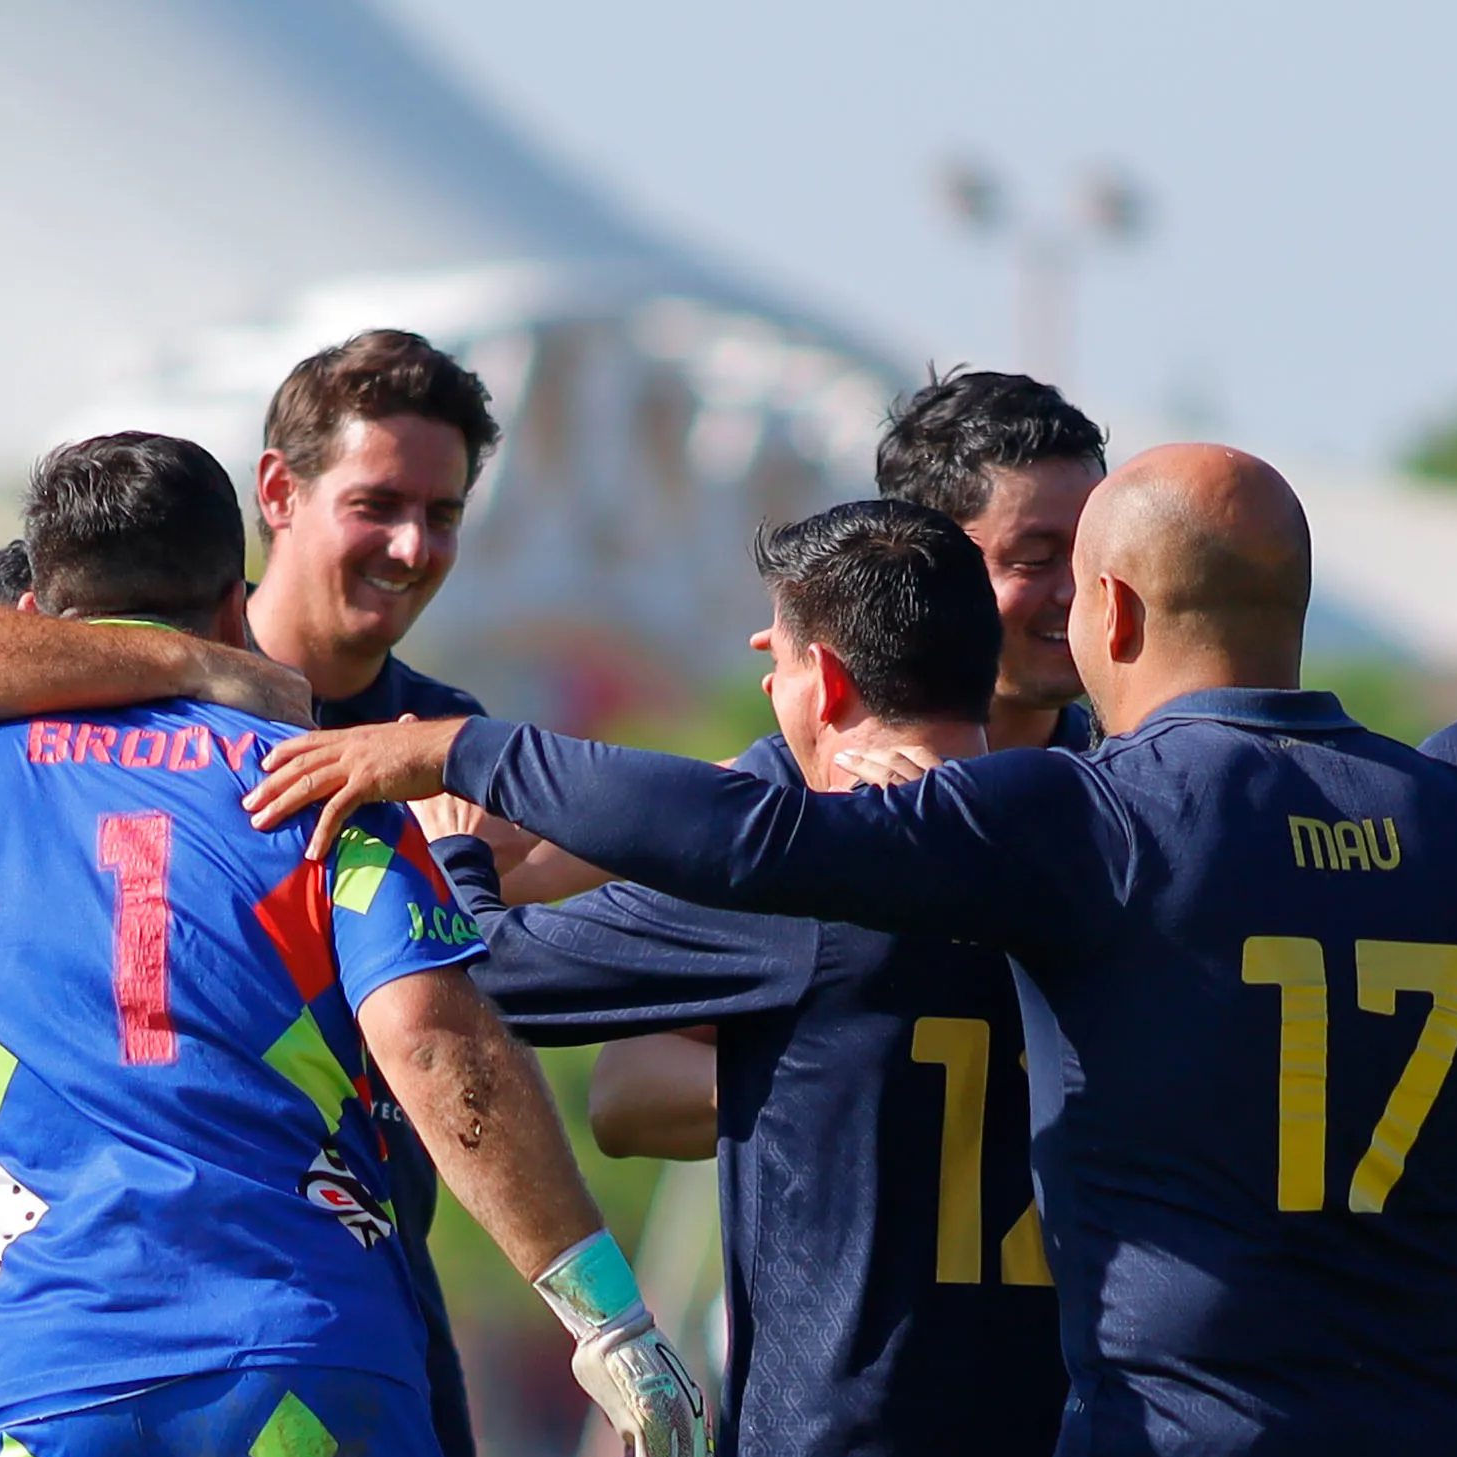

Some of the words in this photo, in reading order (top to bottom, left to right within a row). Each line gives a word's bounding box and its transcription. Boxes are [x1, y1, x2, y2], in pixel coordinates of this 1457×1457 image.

[28, 719, 259, 772] BRODY
[1288, 815, 1401, 870] MAU
[97, 811, 179, 1067] 1
